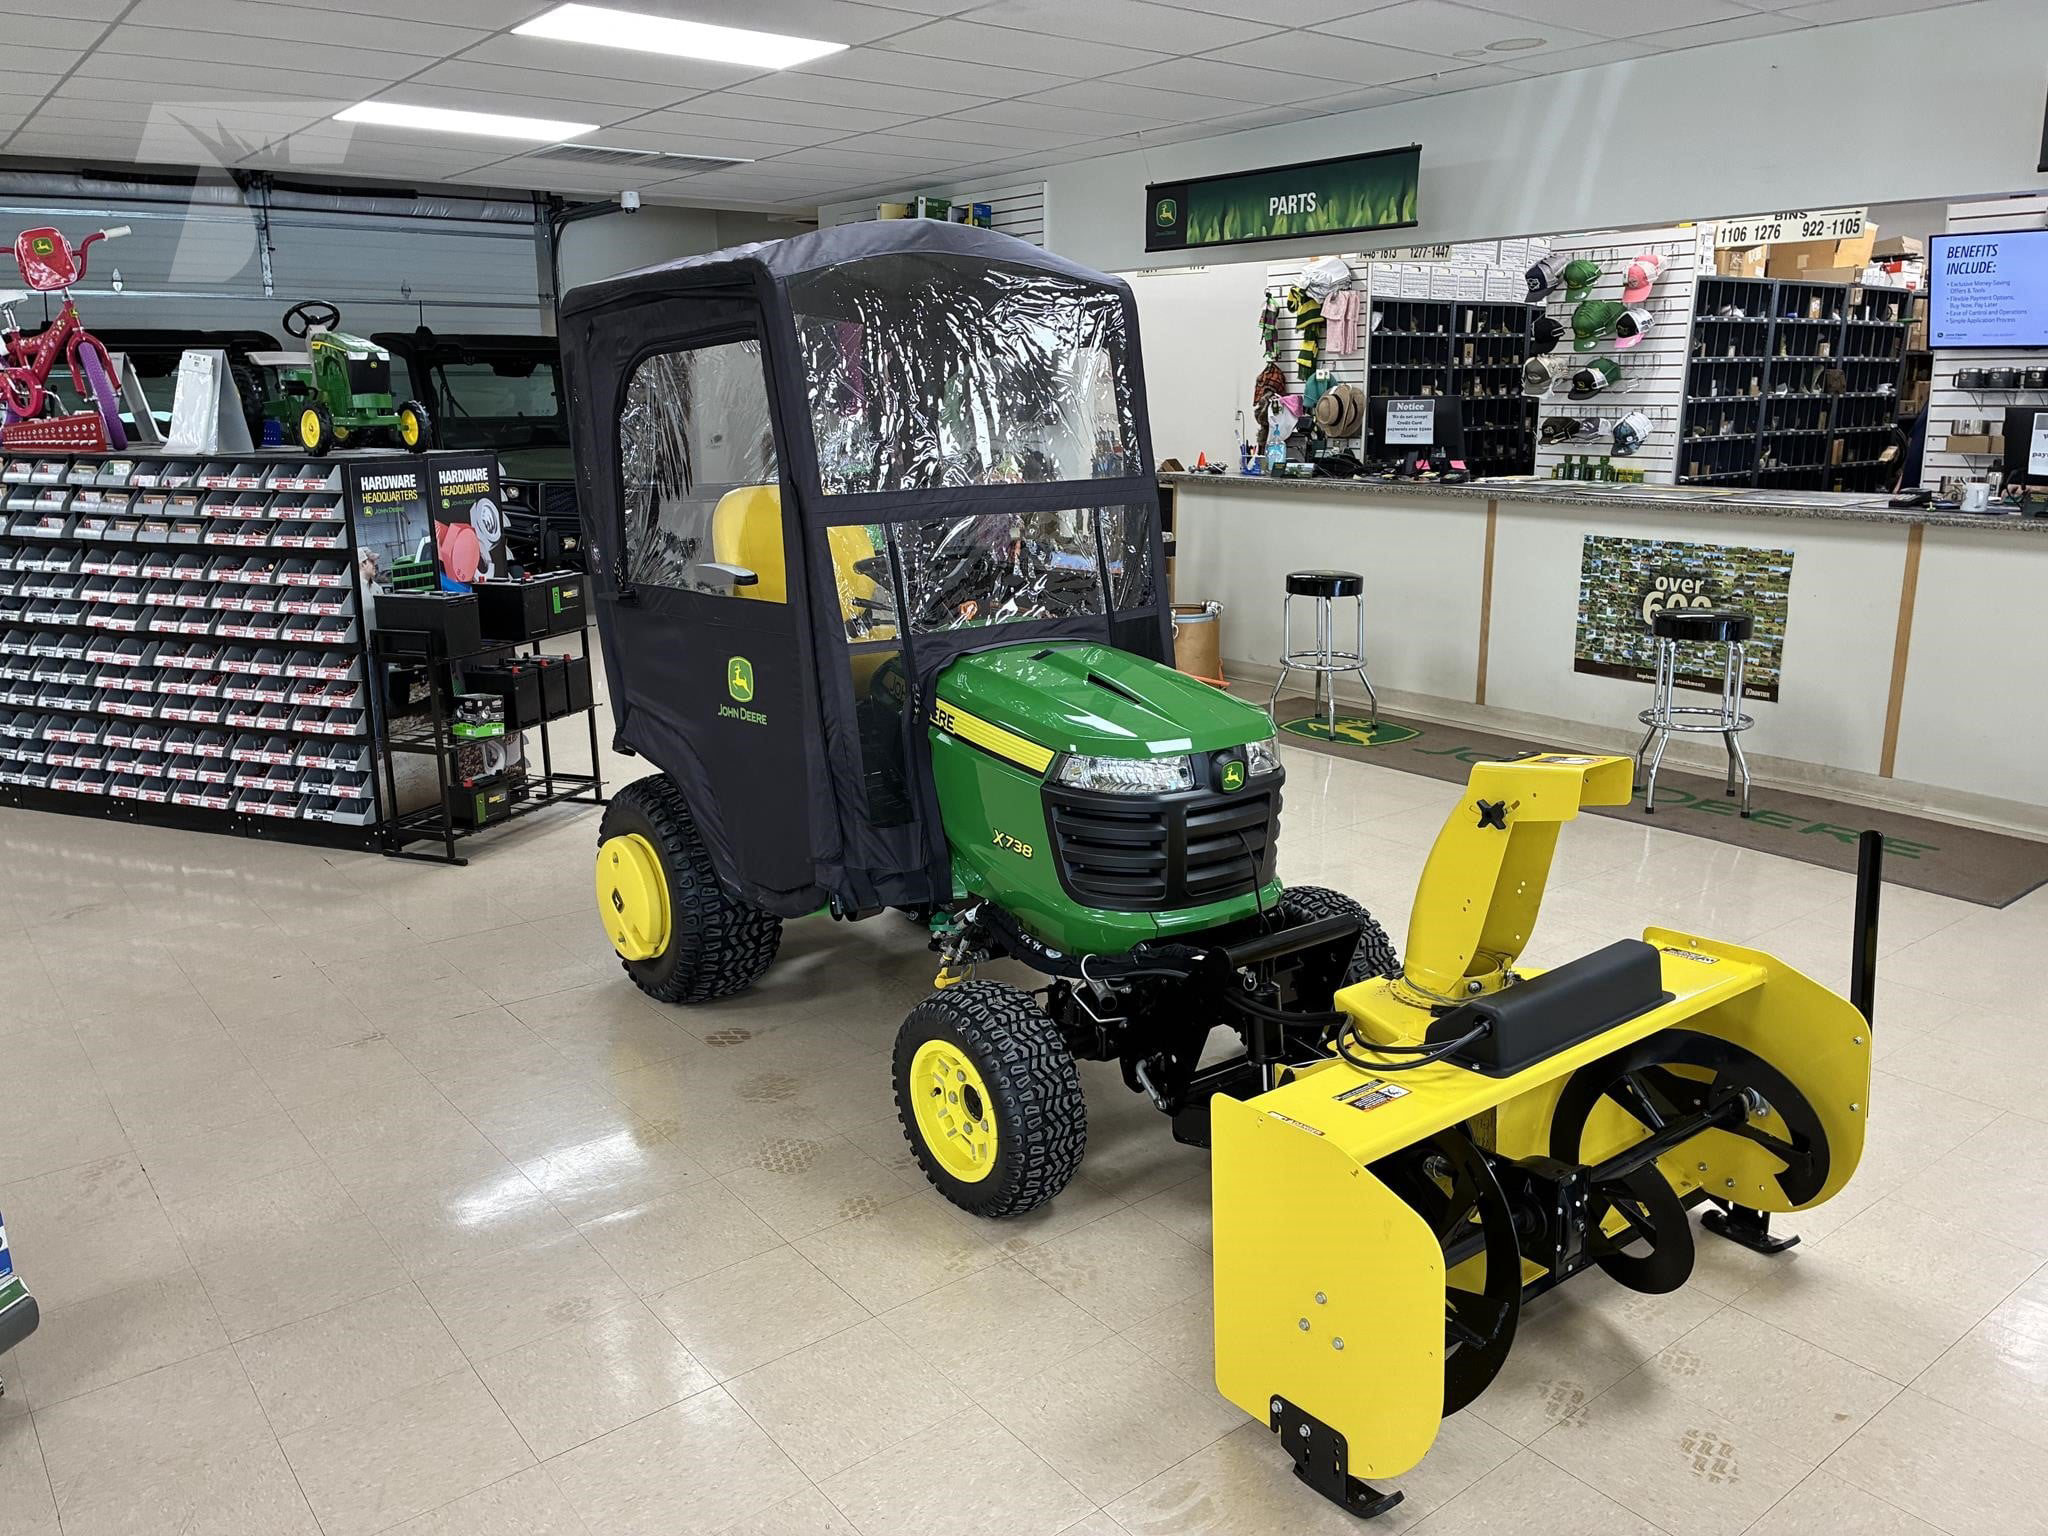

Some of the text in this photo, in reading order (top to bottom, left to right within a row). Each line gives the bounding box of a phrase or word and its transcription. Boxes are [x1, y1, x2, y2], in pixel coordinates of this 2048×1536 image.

[1269, 192, 1317, 217] PARTS
[1774, 211, 1808, 221] BINS
[1721, 226, 1747, 243] 1106
[1754, 223, 1781, 241] 1276
[1947, 244, 1998, 259] BENEFITS
[1947, 261, 1996, 275] INCLUDE:
[360, 474, 417, 491] HARDWARE
[438, 468, 489, 484] HARDWARE
[362, 489, 418, 504] HEADQUARTERS
[440, 482, 490, 496] HEADQUARTERS
[1655, 576, 1705, 594] over
[718, 703, 768, 726] JOHN DEERE
[1633, 784, 1940, 859] DEERE
[992, 828, 1034, 860] X738
